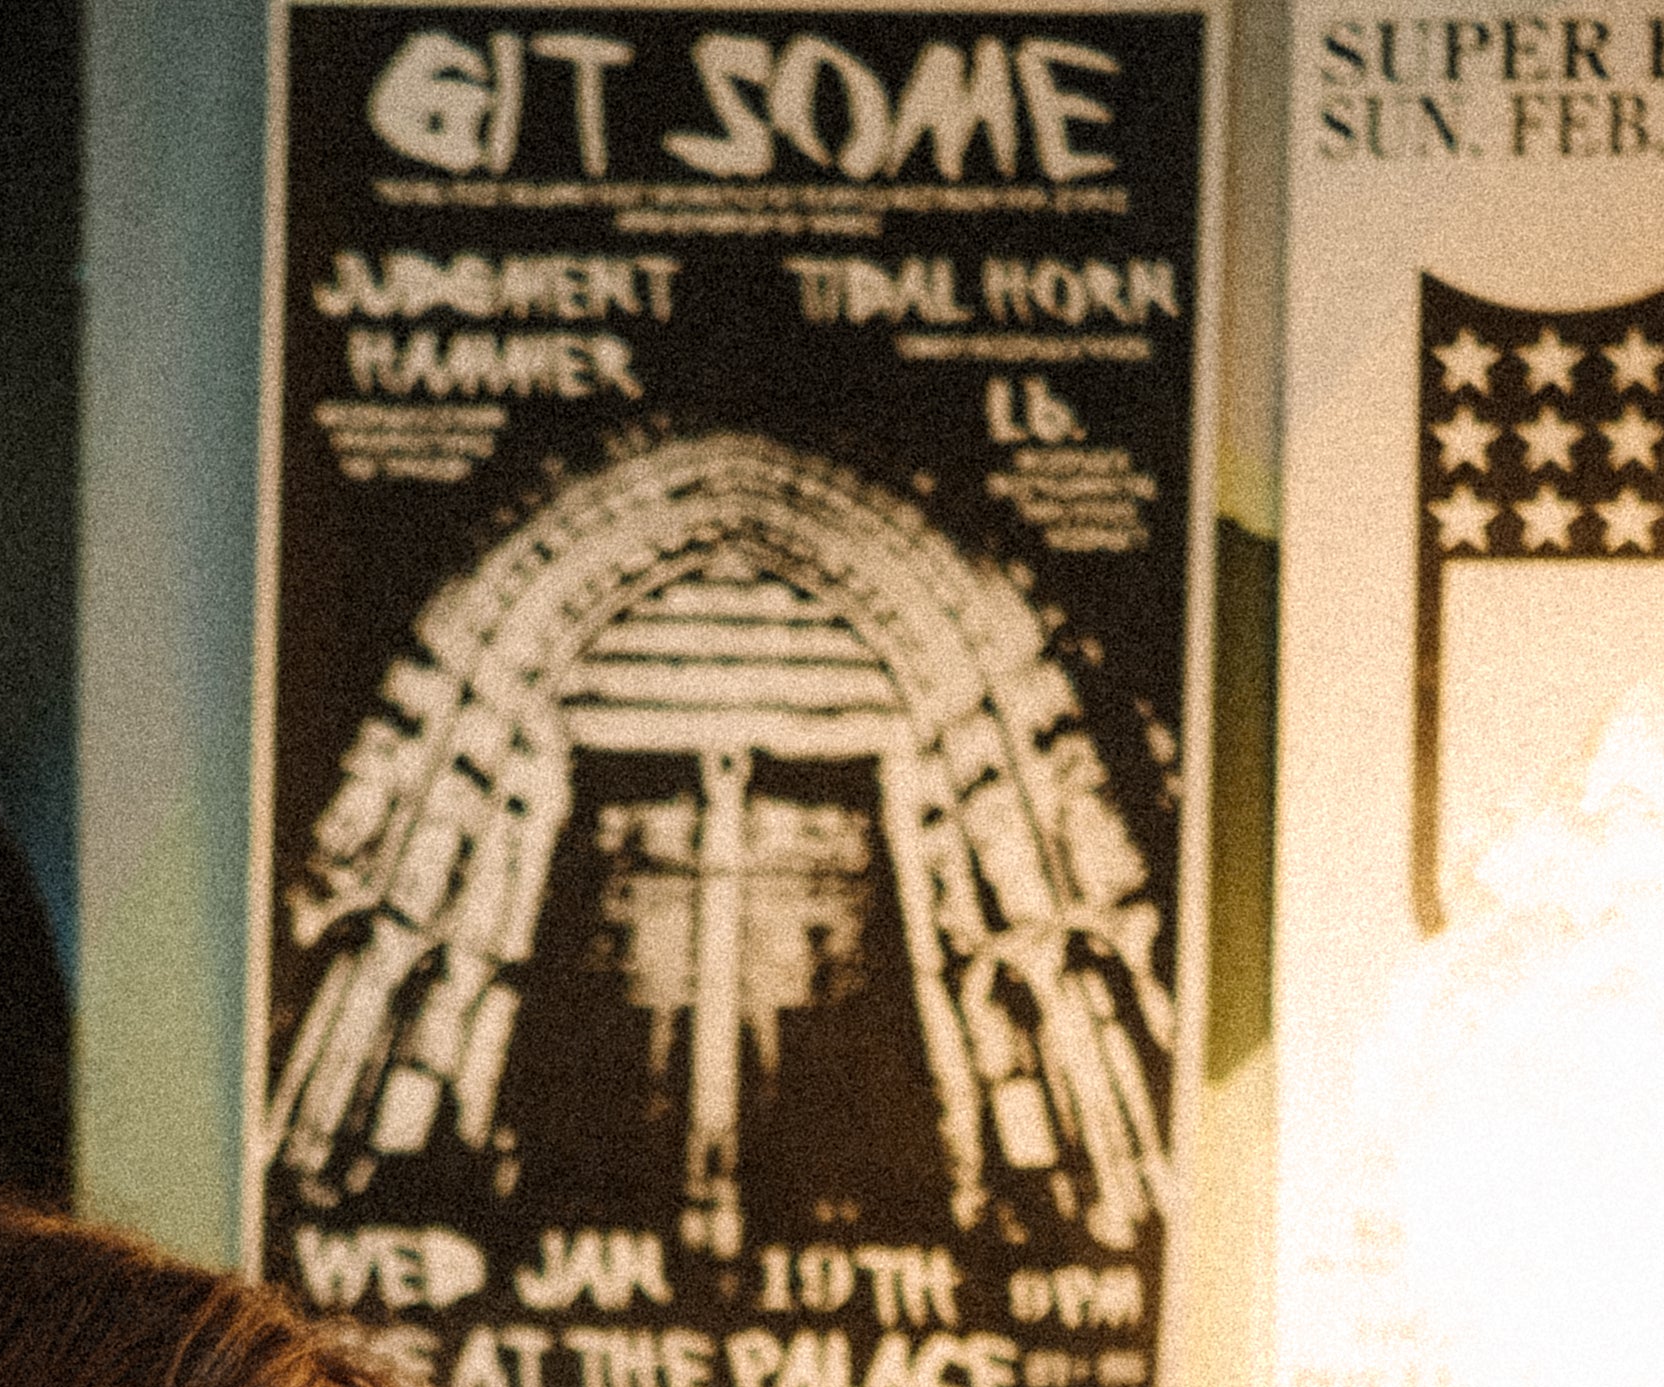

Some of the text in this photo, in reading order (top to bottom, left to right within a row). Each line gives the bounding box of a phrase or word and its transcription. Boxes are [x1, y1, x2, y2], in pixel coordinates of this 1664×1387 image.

[1321, 15, 1610, 86] SUPER
[367, 32, 1122, 182] GIT SOME
[1320, 95, 1484, 159] SUN.
[314, 252, 682, 323] JUDGMENT
[782, 255, 1181, 326] TIDAL HORN
[347, 328, 644, 400] HAMMER
[294, 1224, 487, 1309] WED
[515, 1228, 674, 1310] JAN
[757, 1243, 963, 1328] 10TH
